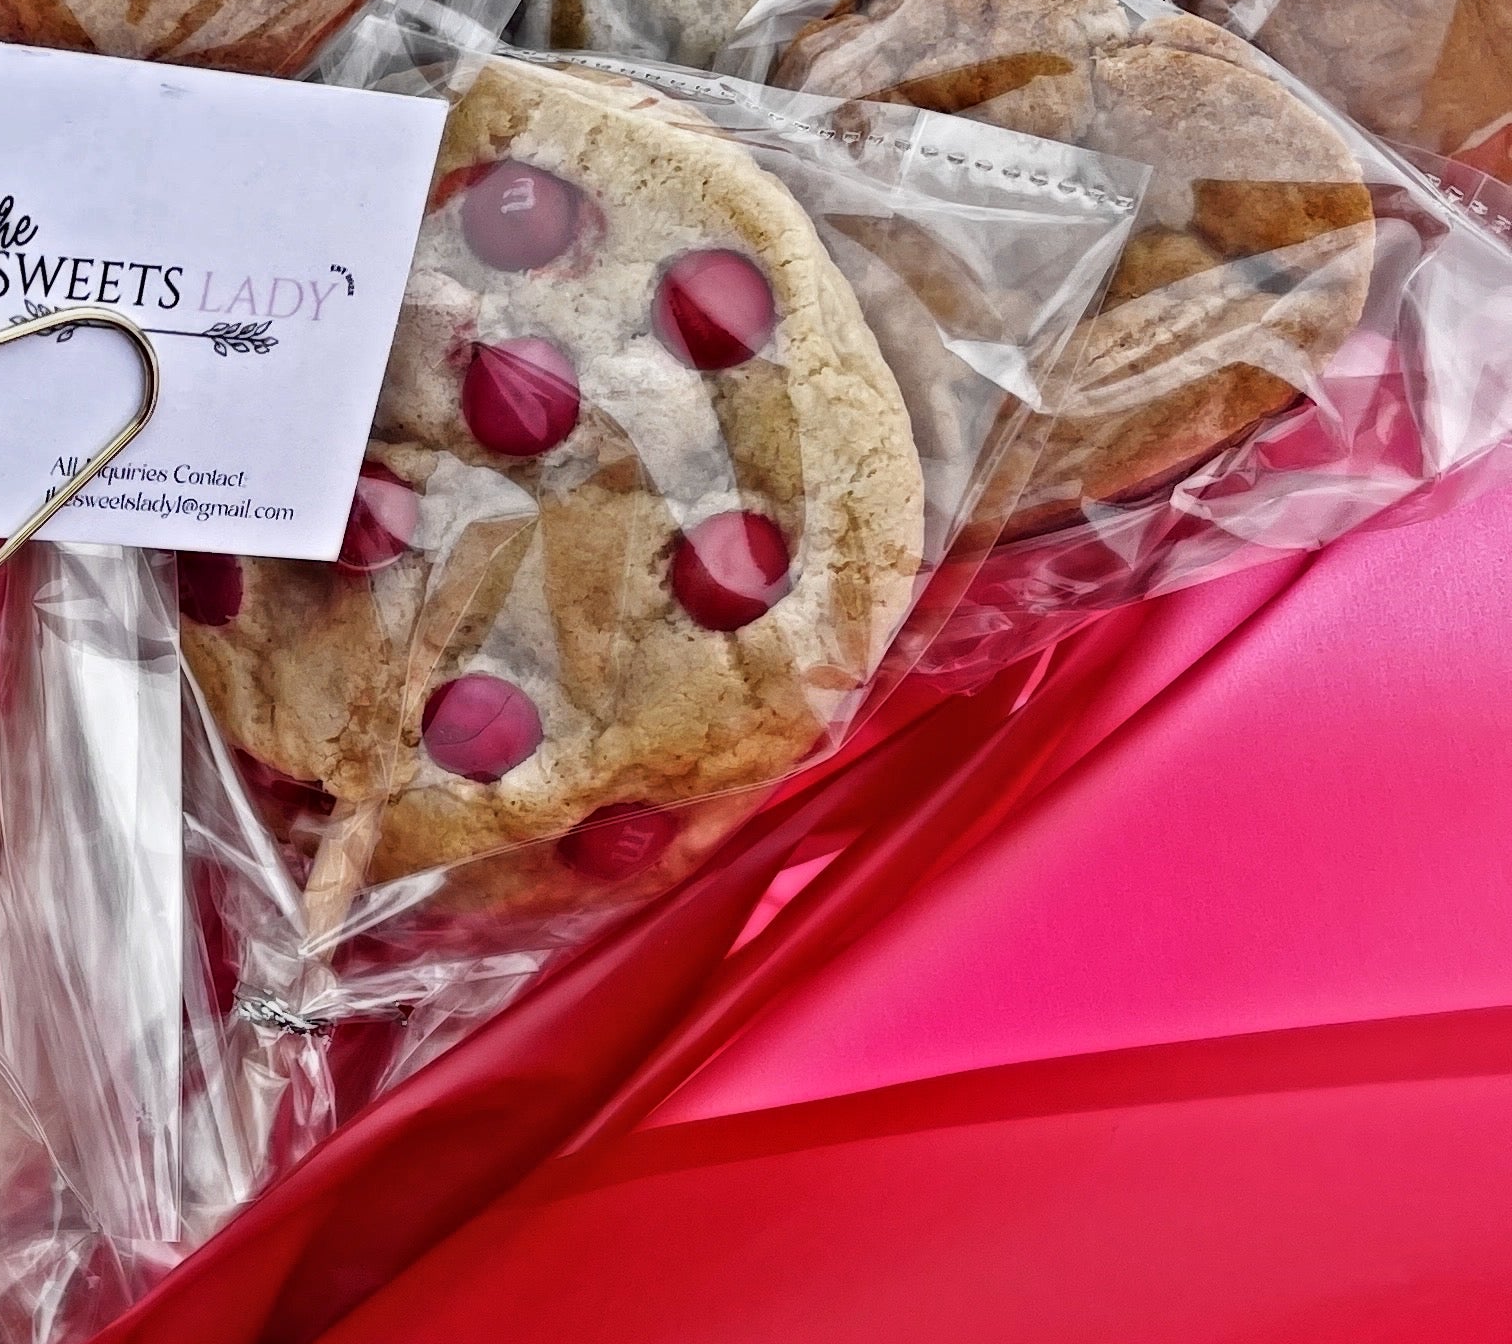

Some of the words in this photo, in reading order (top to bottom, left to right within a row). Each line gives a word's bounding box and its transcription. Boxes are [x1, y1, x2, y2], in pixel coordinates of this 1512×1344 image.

[198, 271, 338, 321] LADY
[50, 456, 78, 477] All
[86, 457, 168, 485] quiries
